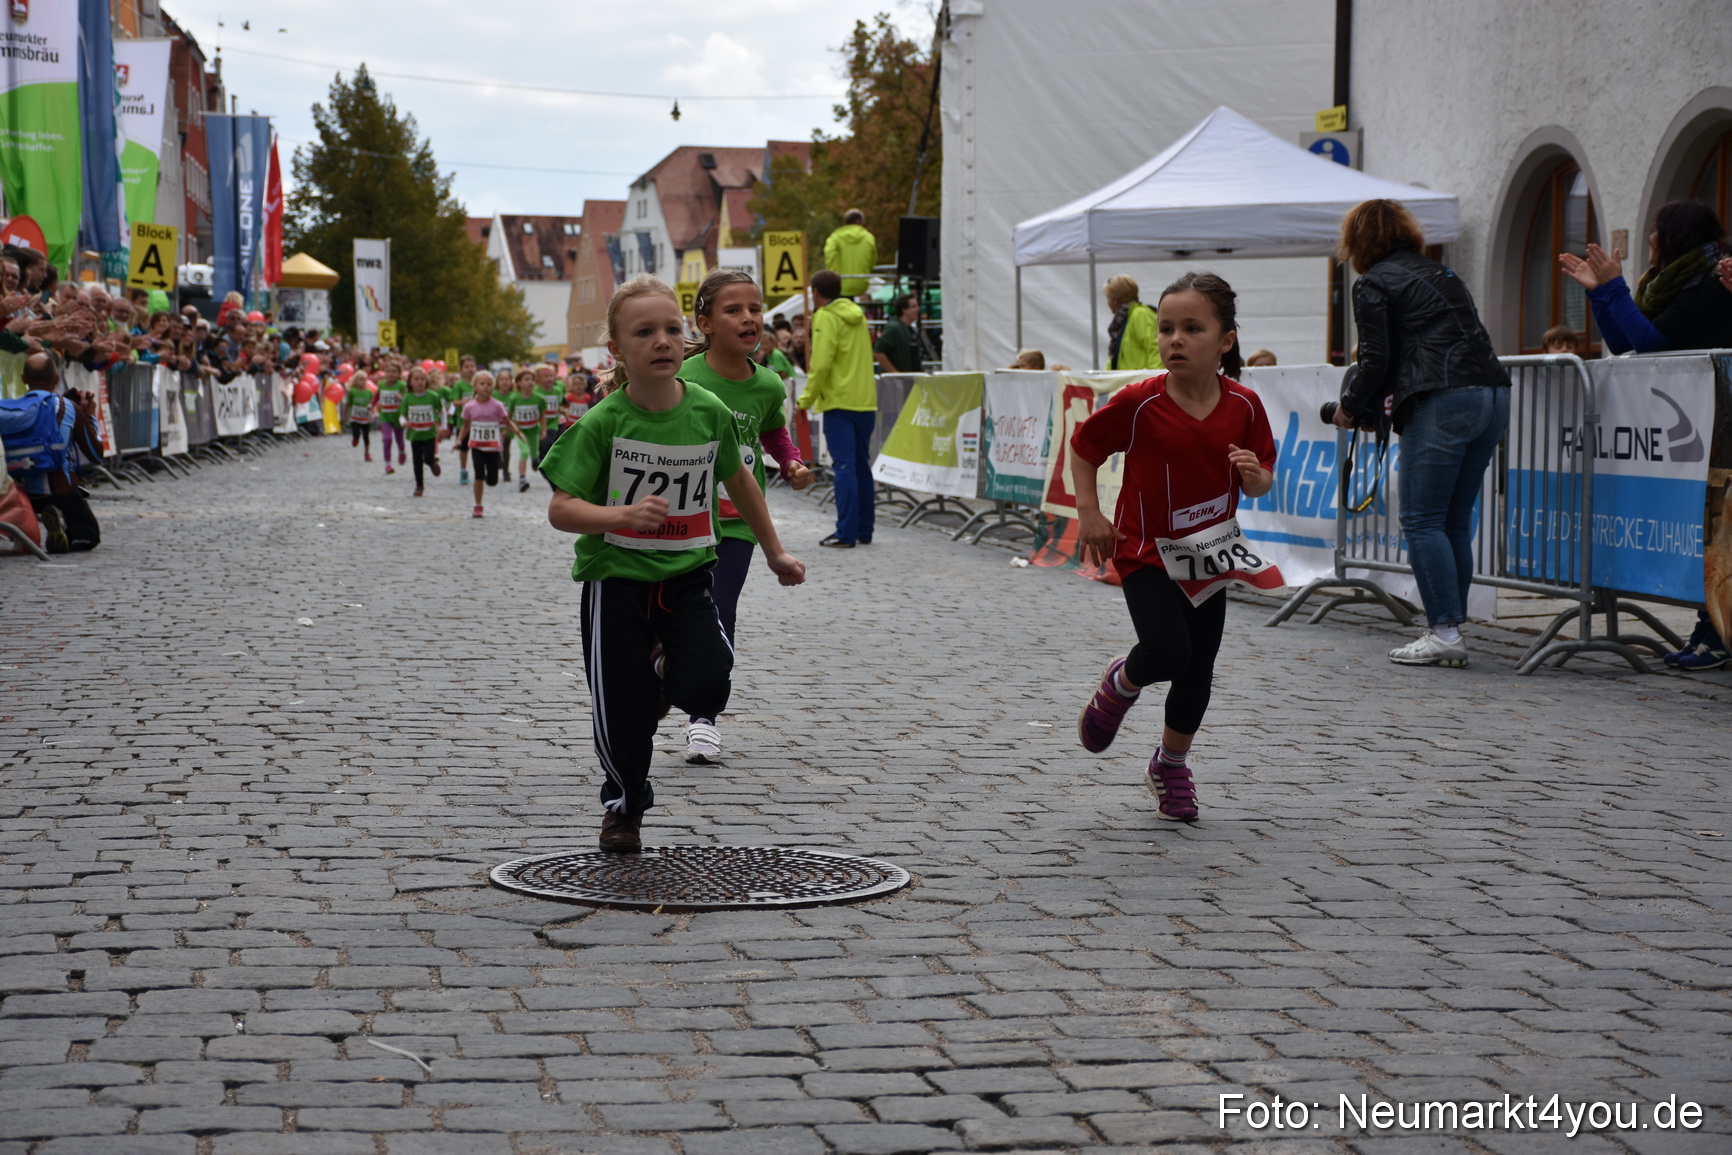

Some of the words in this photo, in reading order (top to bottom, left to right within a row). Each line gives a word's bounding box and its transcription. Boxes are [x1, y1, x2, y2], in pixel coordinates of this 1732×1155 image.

[136, 224, 173, 241] Block
[768, 234, 802, 247] Block
[138, 243, 165, 277] A
[775, 251, 798, 281] A
[681, 293, 694, 312] B
[381, 327, 392, 342] C
[472, 428, 496, 440] 7181
[615, 449, 654, 465] PARTL
[657, 455, 707, 467] Neumarkt
[623, 467, 709, 511] 7214
[1188, 505, 1216, 522] DEHN
[1196, 530, 1234, 553] Neumarkt
[1647, 518, 1704, 558] ZUHAUSE
